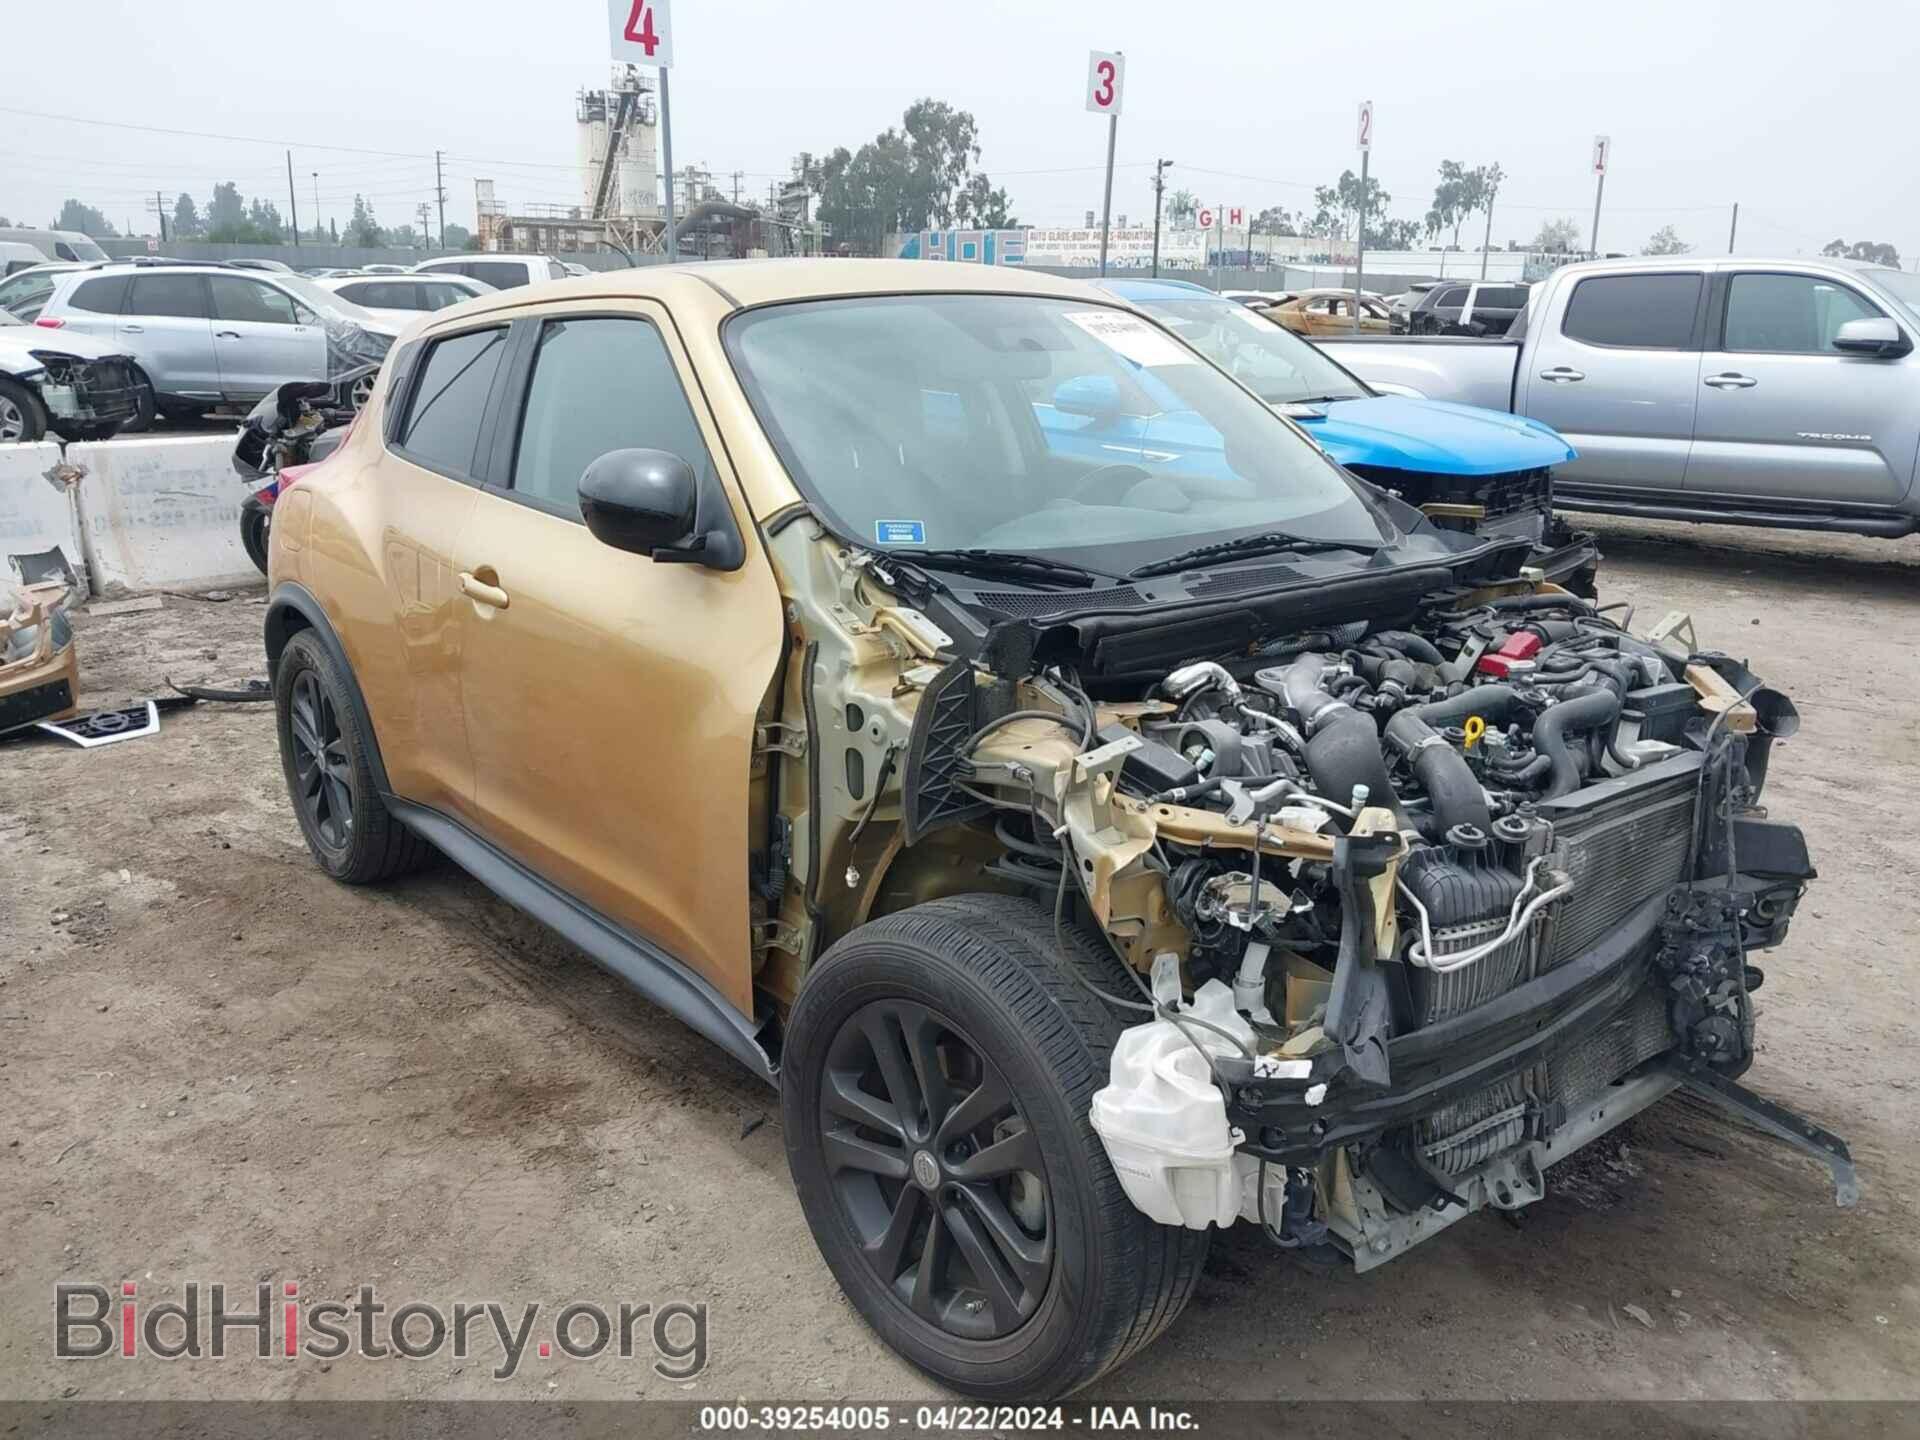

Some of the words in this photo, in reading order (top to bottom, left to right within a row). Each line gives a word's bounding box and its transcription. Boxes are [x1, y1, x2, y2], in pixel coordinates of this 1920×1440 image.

[624, 0, 660, 57] 4
[1095, 60, 1115, 106] 3
[1359, 109, 1370, 145] 2
[1595, 141, 1605, 170] 1
[1199, 210, 1212, 226] G
[1230, 208, 1241, 225] H
[1029, 231, 1047, 241] AUTO
